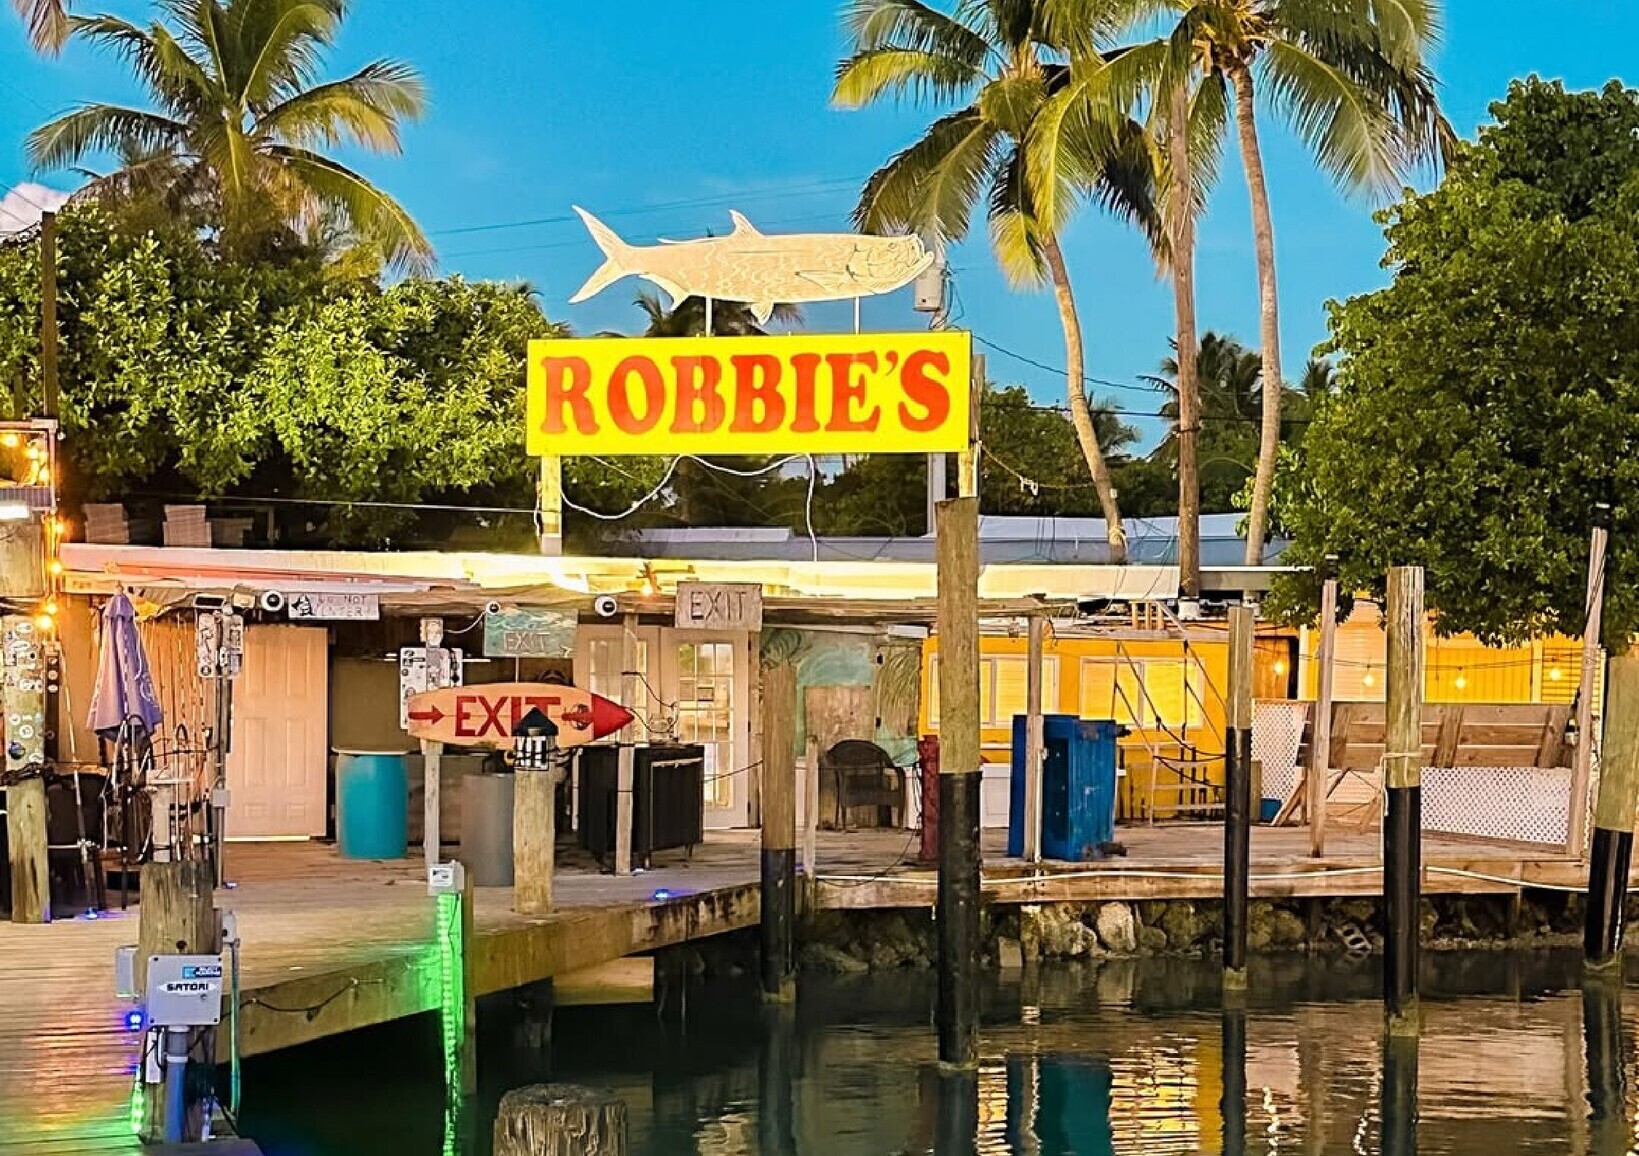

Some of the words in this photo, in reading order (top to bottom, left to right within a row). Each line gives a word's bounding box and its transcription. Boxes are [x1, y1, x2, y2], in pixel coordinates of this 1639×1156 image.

[540, 350, 951, 436] ROBBIE'S
[344, 595, 367, 605] NOT
[691, 591, 746, 621] EXIT
[503, 631, 551, 653] EXIT
[166, 983, 209, 992] SATORI
